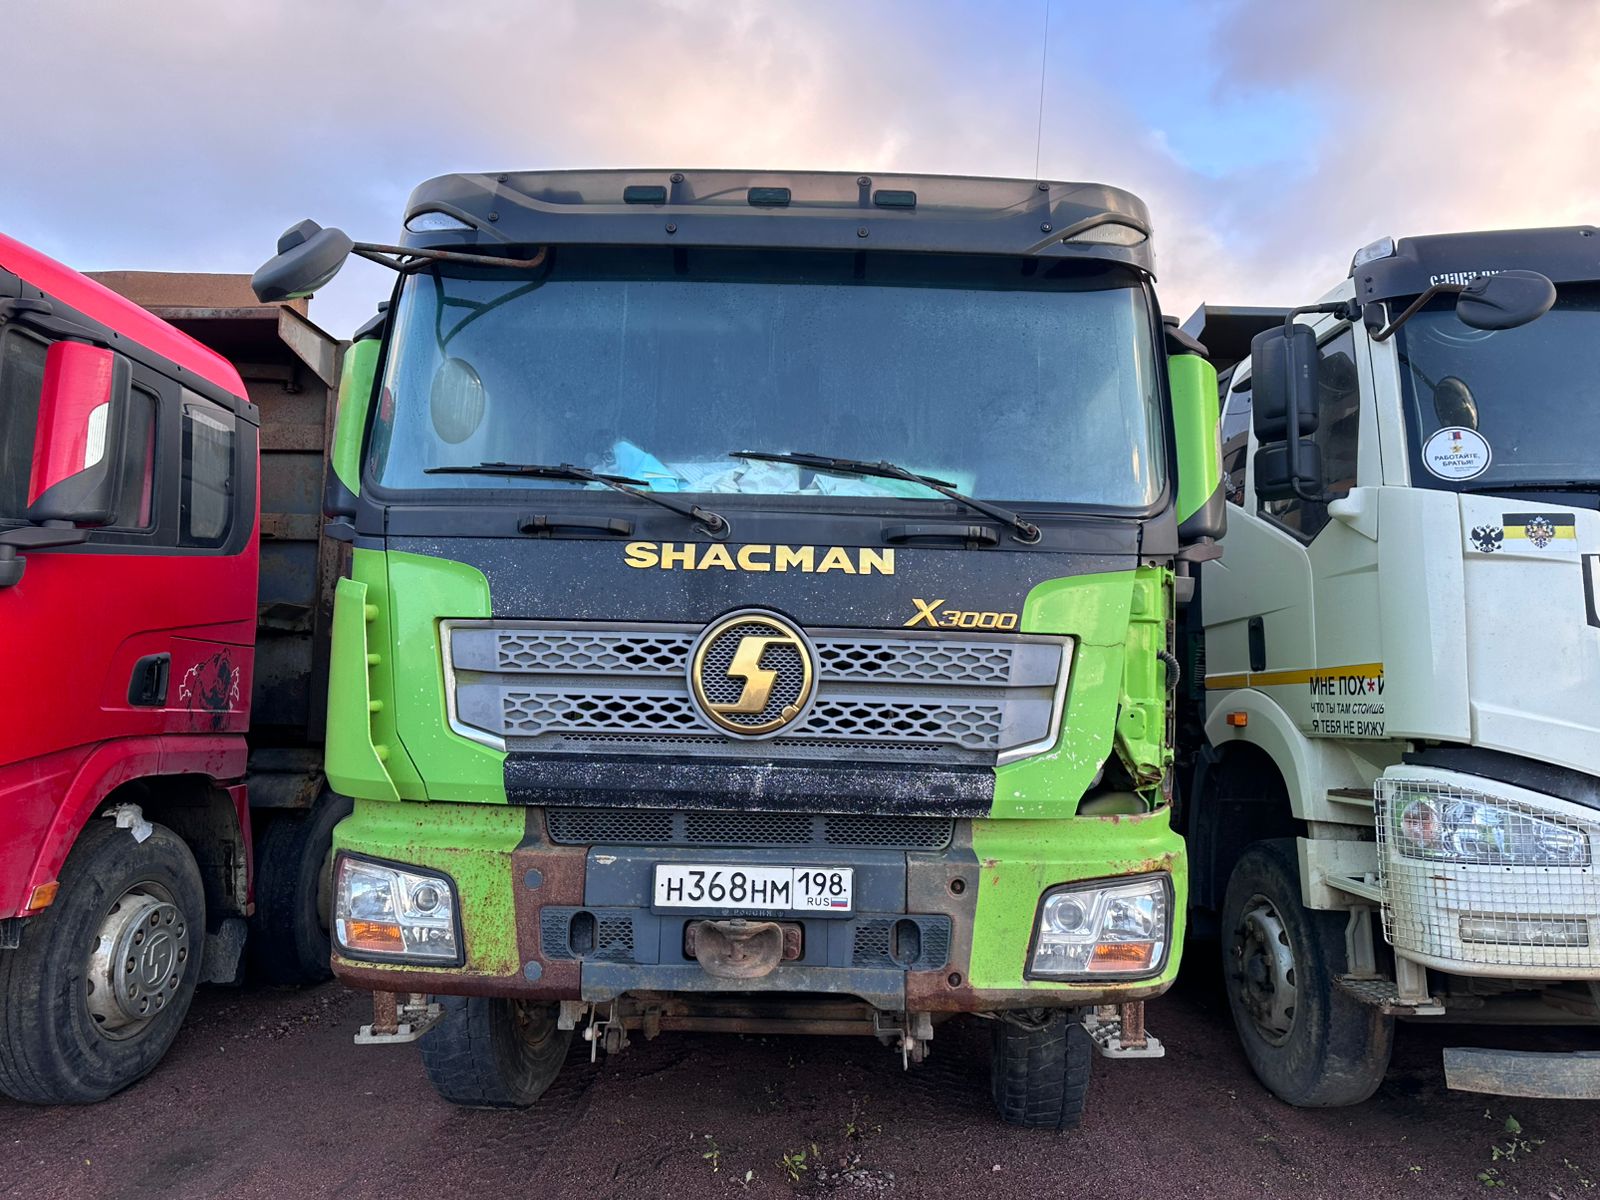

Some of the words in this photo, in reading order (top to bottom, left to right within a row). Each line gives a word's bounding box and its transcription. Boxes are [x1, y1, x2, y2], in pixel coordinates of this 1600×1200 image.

[623, 541, 895, 575] SHACMAN
[903, 598, 1018, 630] X3000
[1309, 675, 1336, 695] МНЕ
[1310, 702, 1325, 713] ЧТО
[1326, 702, 1336, 713] ТЫ
[1337, 702, 1351, 714] ТАМ
[1352, 703, 1385, 715] СТОИШЬ
[1312, 719, 1320, 733] Я
[1321, 719, 1342, 733] ТЕБЯ
[1343, 720, 1355, 735] НЕ
[1357, 721, 1385, 736] ВИЖУ
[798, 871, 843, 896] 198
[807, 897, 830, 907] RUS
